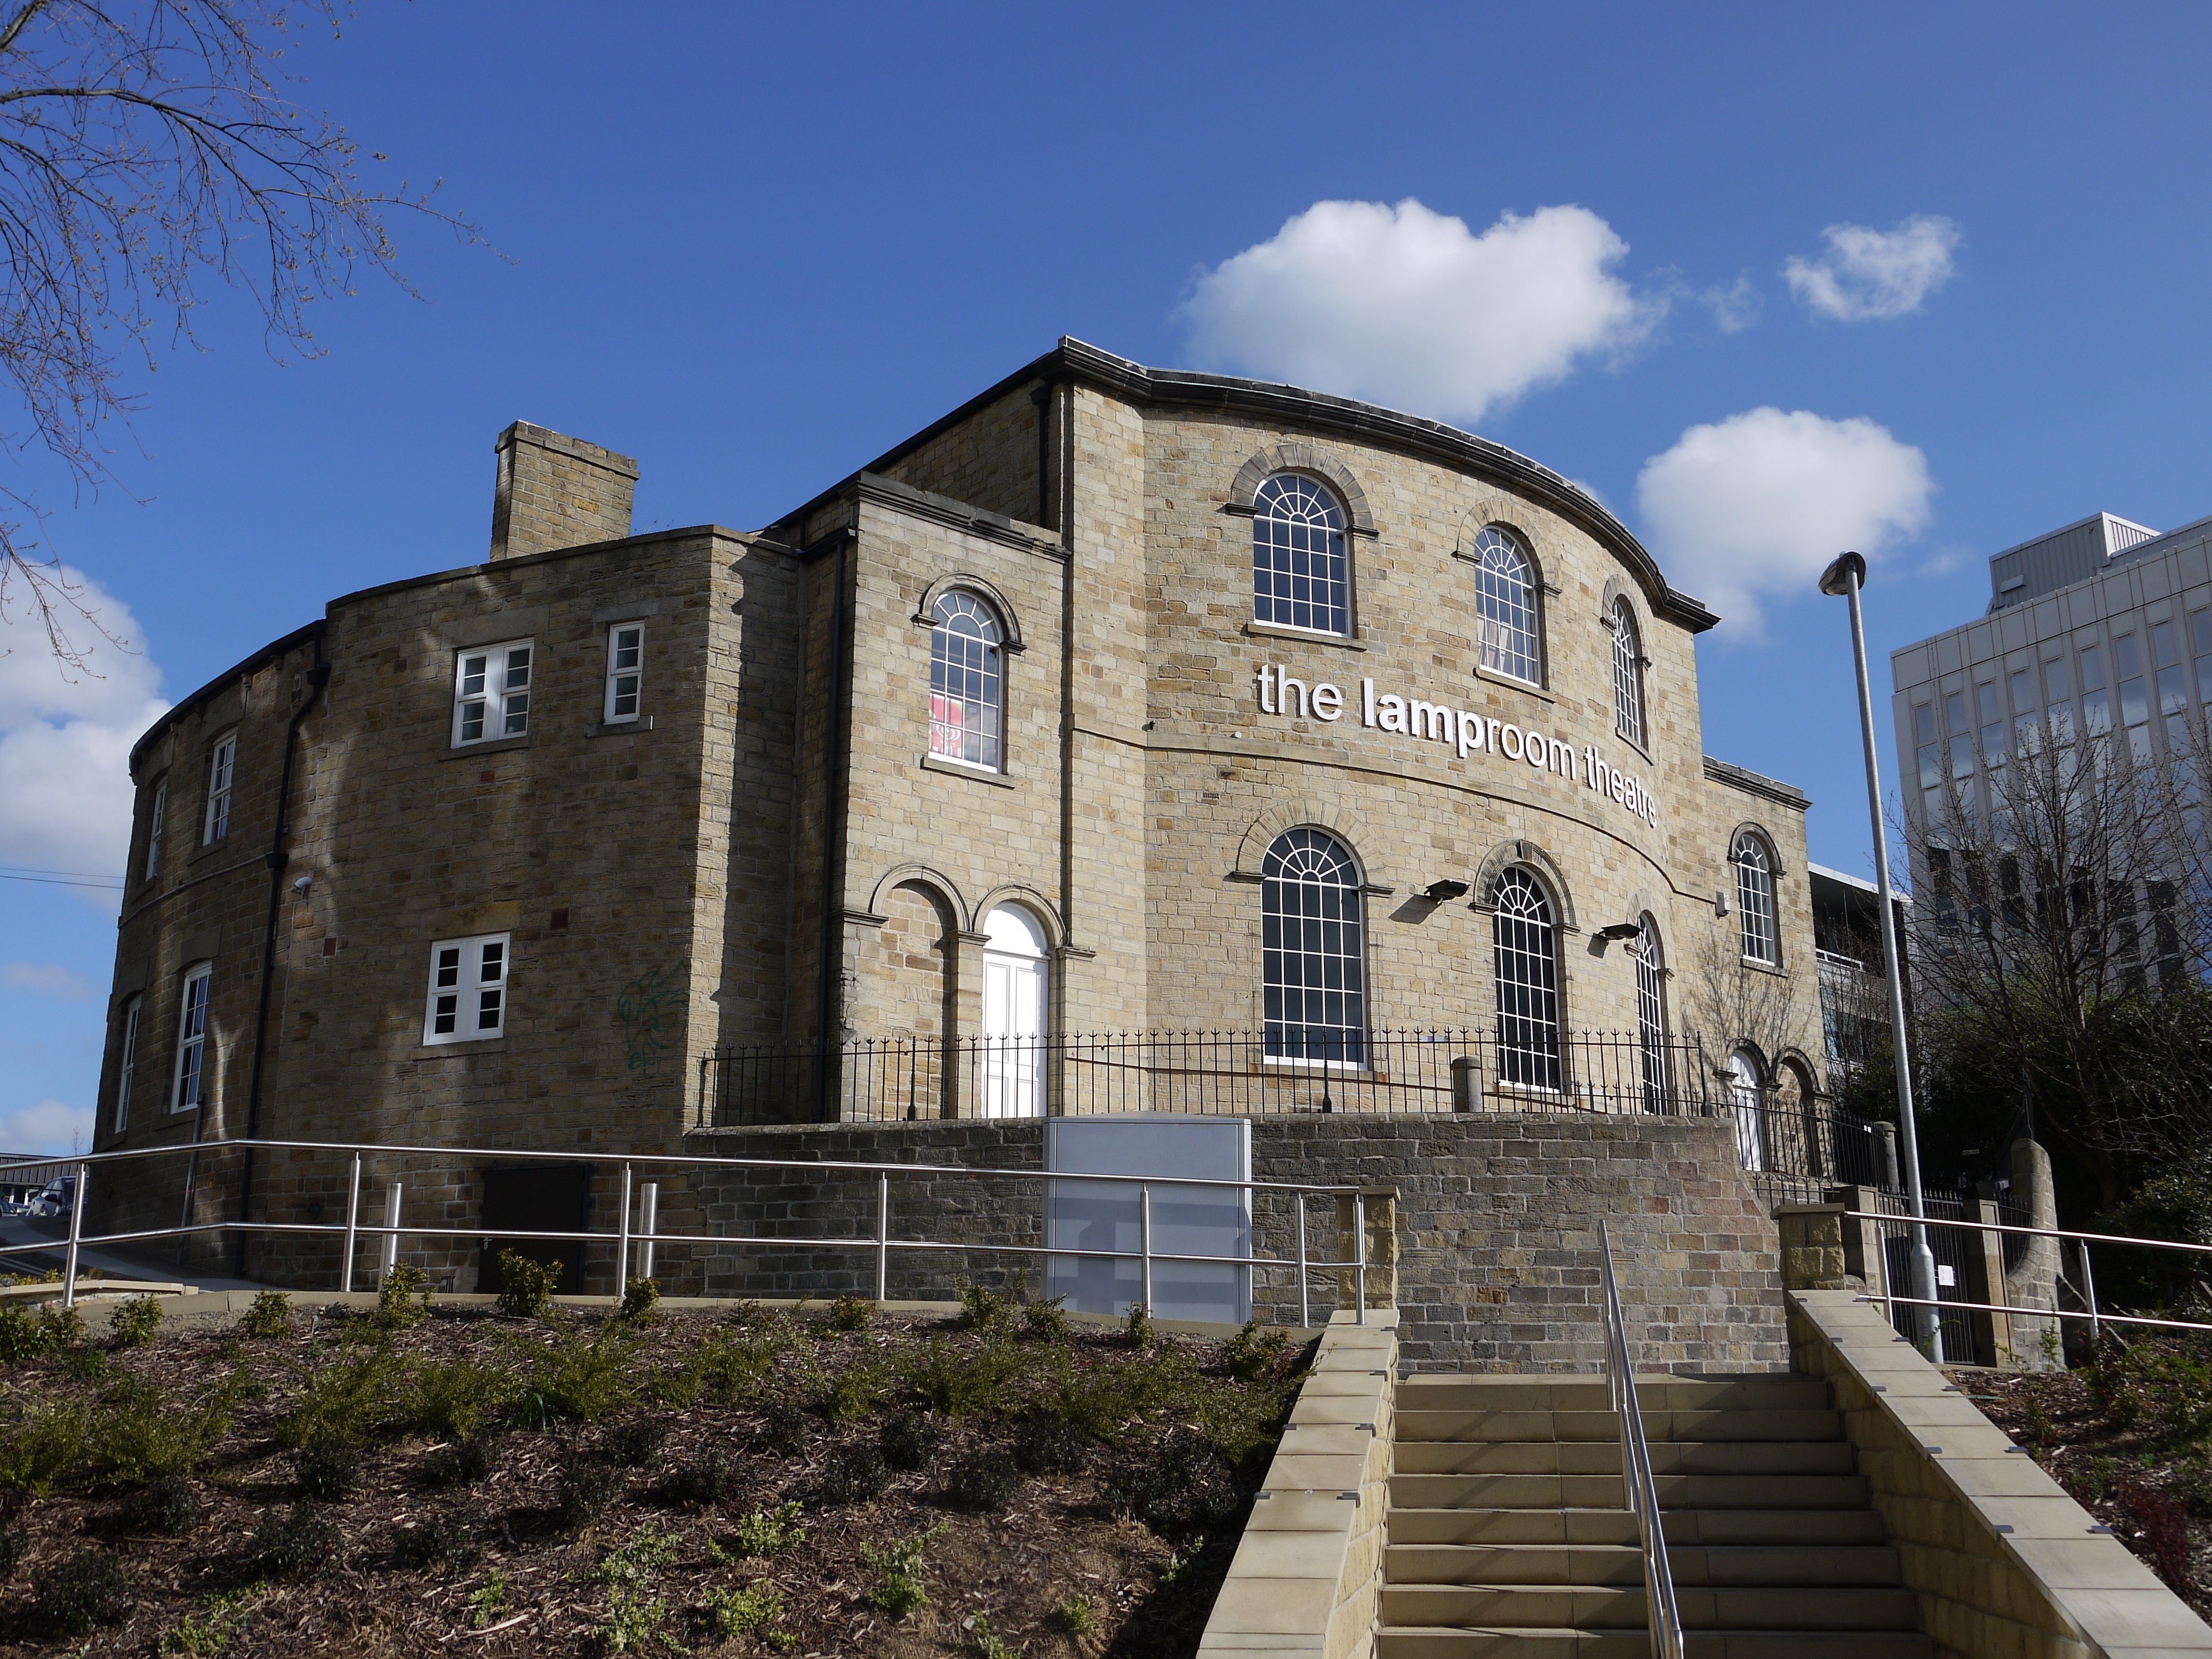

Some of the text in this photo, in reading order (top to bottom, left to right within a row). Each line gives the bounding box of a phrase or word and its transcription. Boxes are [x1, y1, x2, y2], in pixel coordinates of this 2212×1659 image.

[1258, 664, 1657, 828] the lamproom theatre
